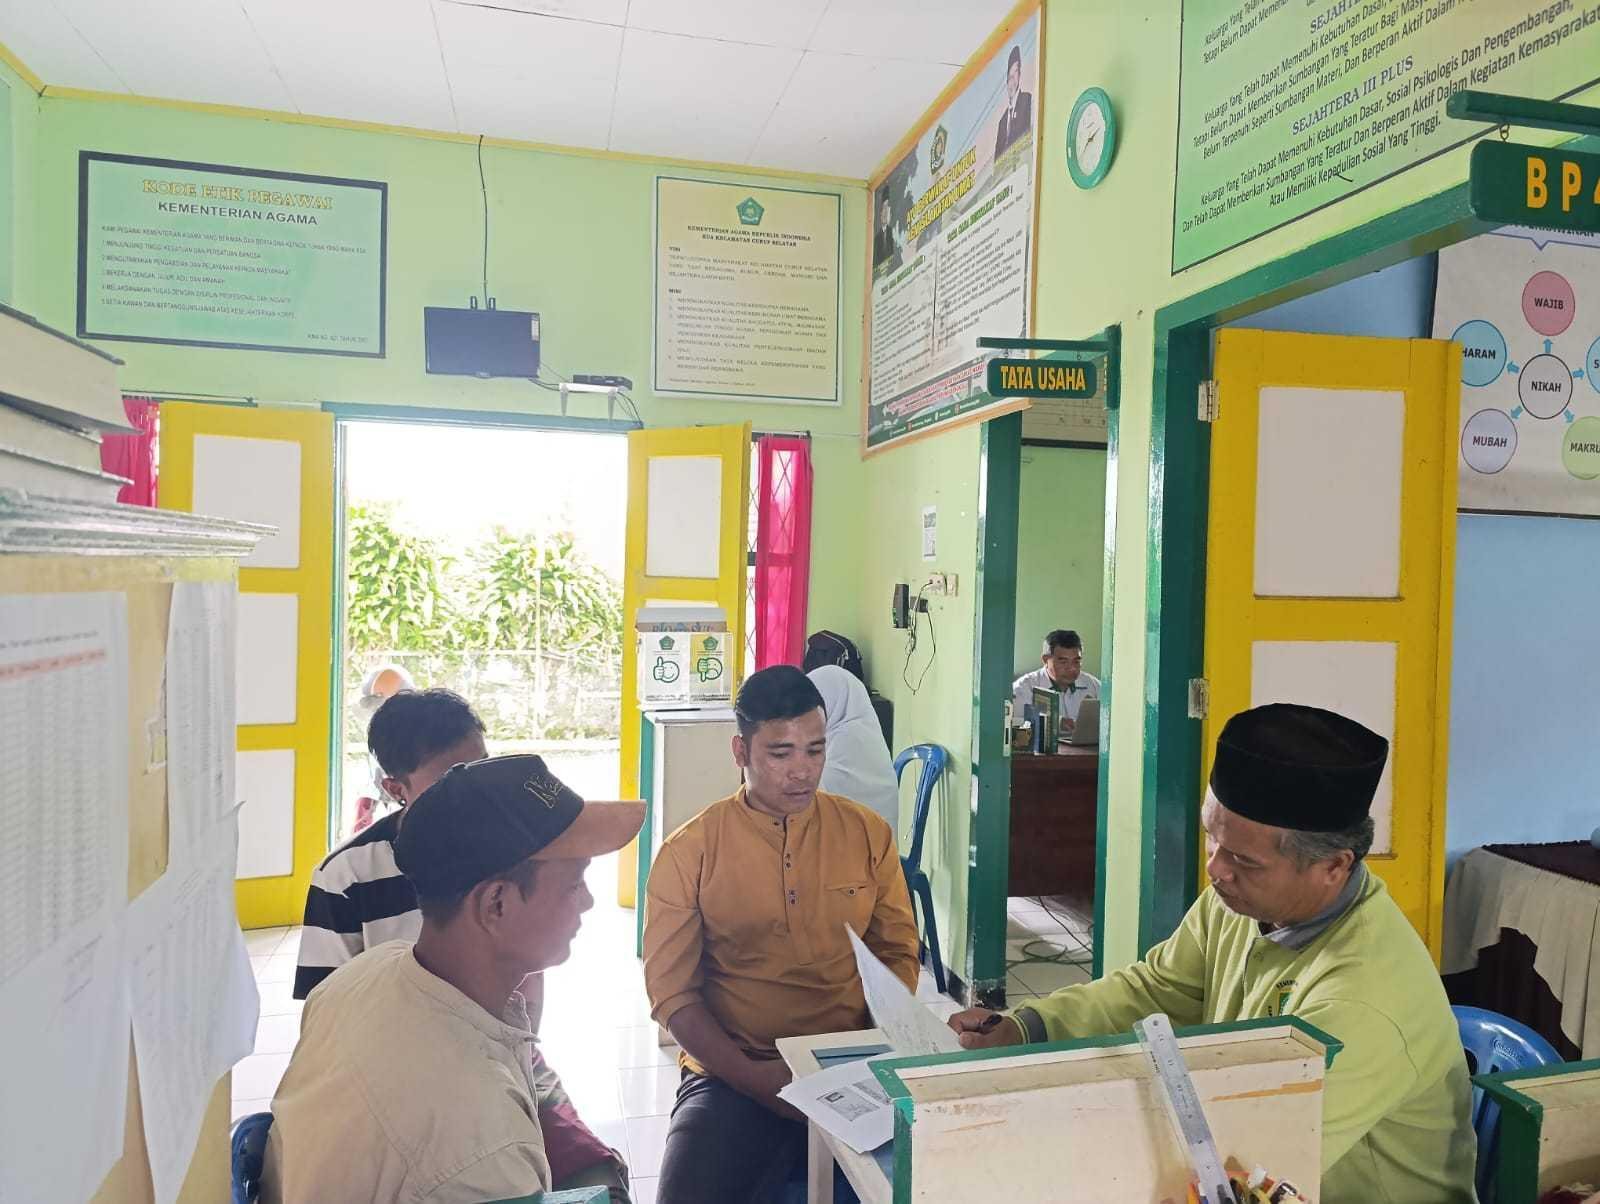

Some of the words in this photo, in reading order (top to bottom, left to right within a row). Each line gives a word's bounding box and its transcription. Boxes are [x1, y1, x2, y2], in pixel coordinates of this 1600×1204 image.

[1230, 10, 1243, 26] Yang
[1220, 31, 1239, 53] Belum
[1240, 17, 1257, 38] Dapat
[1203, 141, 1221, 160] Belum
[1251, 105, 1275, 130] Seperti
[1275, 83, 1315, 116] Sumbangan
[1316, 63, 1343, 91] Materi,
[1345, 56, 1360, 74] Dan
[1362, 31, 1400, 63] Berperan
[1402, 11, 1424, 39] Aktif
[1426, 0, 1455, 24] Dalam
[1204, 102, 1228, 123] Keluarga
[1229, 92, 1243, 106] Yang
[1244, 78, 1260, 97] Telah
[1261, 65, 1280, 87] Dapat
[1281, 39, 1318, 73] Memenuhi
[1320, 14, 1361, 49] Kebutuhan
[1210, 119, 1228, 138] Belum
[1229, 106, 1246, 126] Dapat
[1248, 82, 1287, 113] Memberikan
[1289, 53, 1329, 88] Sumbangan
[1331, 41, 1349, 61] Yang
[1351, 21, 1379, 49] Teratur
[1381, 5, 1399, 29] Bagi
[1200, 185, 1225, 206] Keluarga
[1225, 177, 1240, 193] Yang
[1240, 167, 1257, 185] Telah
[1259, 157, 1277, 176] Dapat
[1278, 132, 1316, 165] Memenuhi
[1317, 112, 1358, 144] Kebutuhan
[1360, 99, 1384, 122] Dasar,
[1387, 79, 1411, 107] Sosial
[1414, 56, 1459, 92] Psikologis
[1462, 45, 1481, 67] Dan
[1484, 0, 1573, 54] Pengembangan,
[1292, 87, 1360, 136] SEJAHTERA
[1362, 75, 1377, 97] III
[1380, 55, 1414, 86] PLUS
[1182, 219, 1192, 233] Dan
[1194, 210, 1208, 228] Telah
[1209, 201, 1226, 219] Dapat
[1227, 182, 1265, 211] Memberikan
[1266, 161, 1305, 192] Sumbangan
[1306, 151, 1324, 170] Yang
[1325, 135, 1352, 161] Teratur
[1354, 127, 1370, 146] Dan
[1371, 105, 1411, 137] Berperan
[1413, 88, 1436, 116] Aktif
[1437, 77, 1467, 102] Dalam
[1470, 51, 1515, 85] Kegiatan
[1269, 193, 1285, 208] Atau
[1286, 172, 1317, 200] Memiliki
[1319, 153, 1361, 184] Kepedulian
[1362, 136, 1386, 162] Sosial
[1388, 127, 1409, 149] Yang
[1411, 110, 1441, 138] Tinggi.
[142, 179, 197, 197] KODE
[202, 184, 242, 201] ETIK
[247, 189, 333, 210] PEGAWAI
[158, 201, 262, 220] KEMENTERIAN
[266, 212, 318, 225] AGAMA
[687, 225, 729, 234] KEMENTERIAN
[752, 231, 779, 239] REPUBLIK
[715, 235, 750, 243] KECAMATAN
[1534, 297, 1564, 310] WAJIB
[1001, 365, 1034, 389] TATA
[1038, 367, 1086, 391] USAHA
[1531, 380, 1562, 393] NIKAH
[1472, 435, 1508, 448] MUBAH
